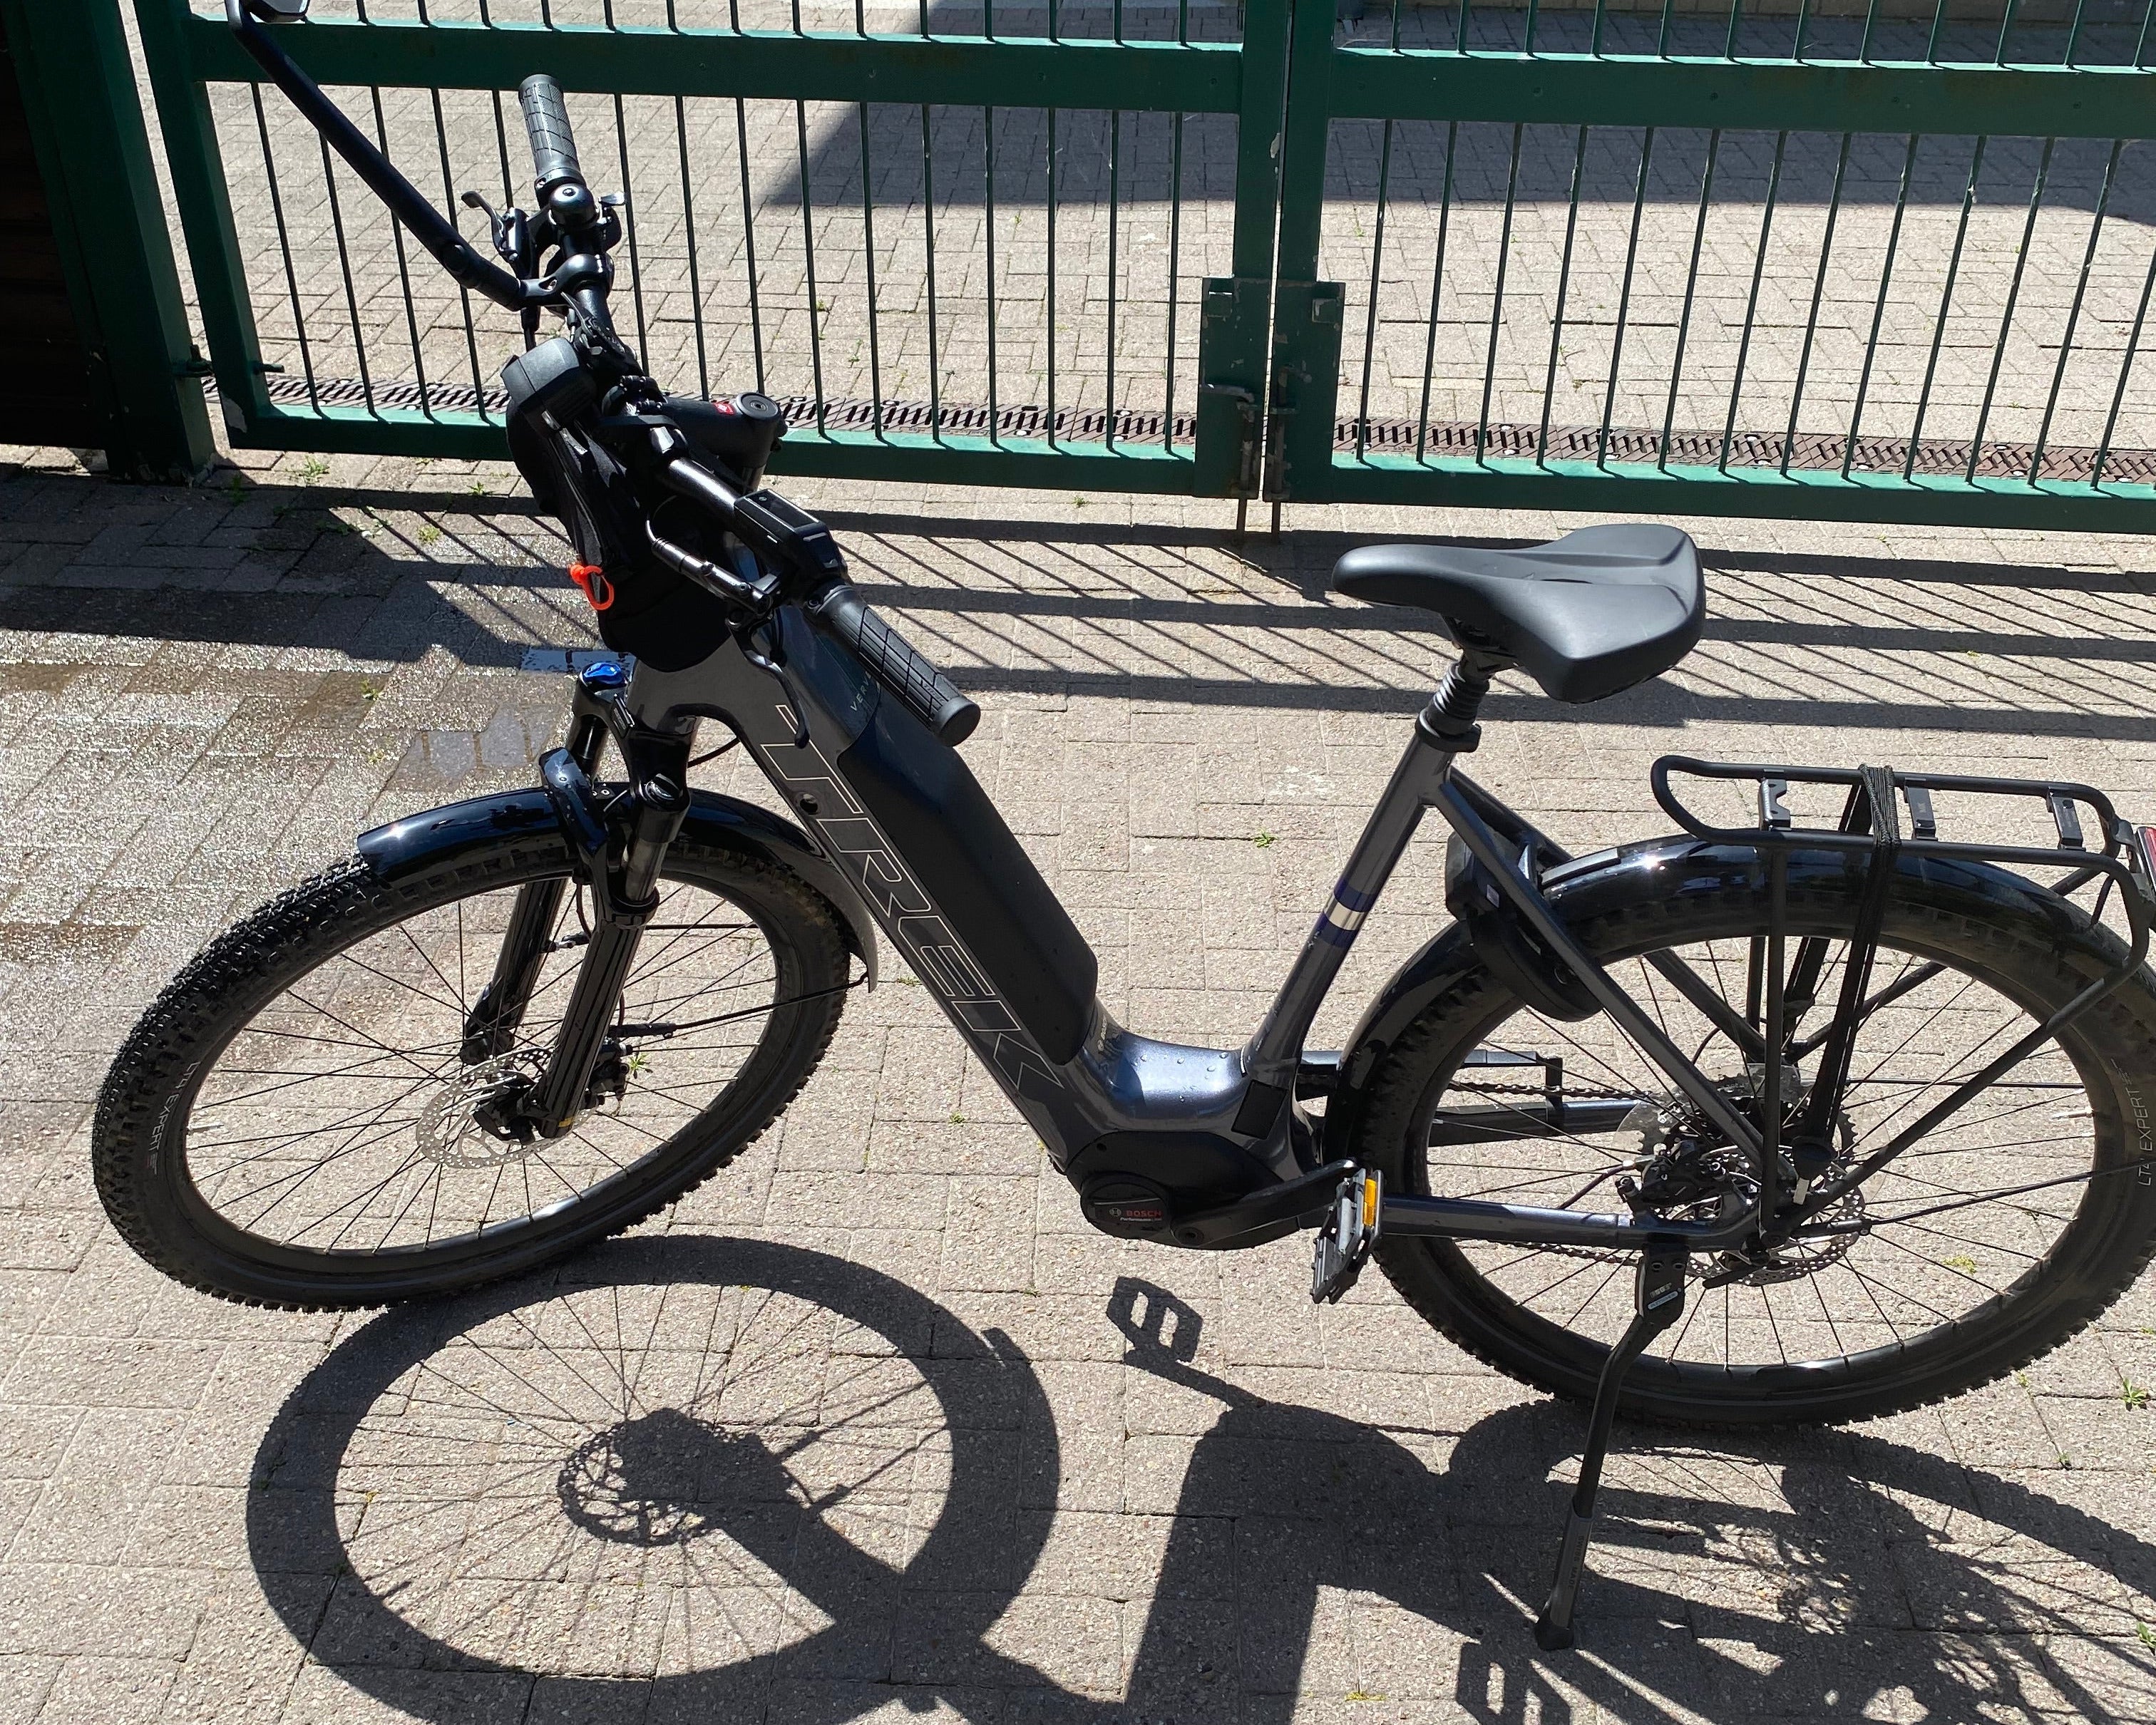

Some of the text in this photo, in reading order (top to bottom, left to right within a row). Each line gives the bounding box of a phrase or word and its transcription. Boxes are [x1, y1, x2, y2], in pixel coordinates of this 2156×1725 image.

[850, 671, 871, 711] VERV
[761, 705, 1064, 1088] TREK
[148, 1093, 179, 1150] EXPERT
[2125, 1087, 2152, 1151] EXPERT
